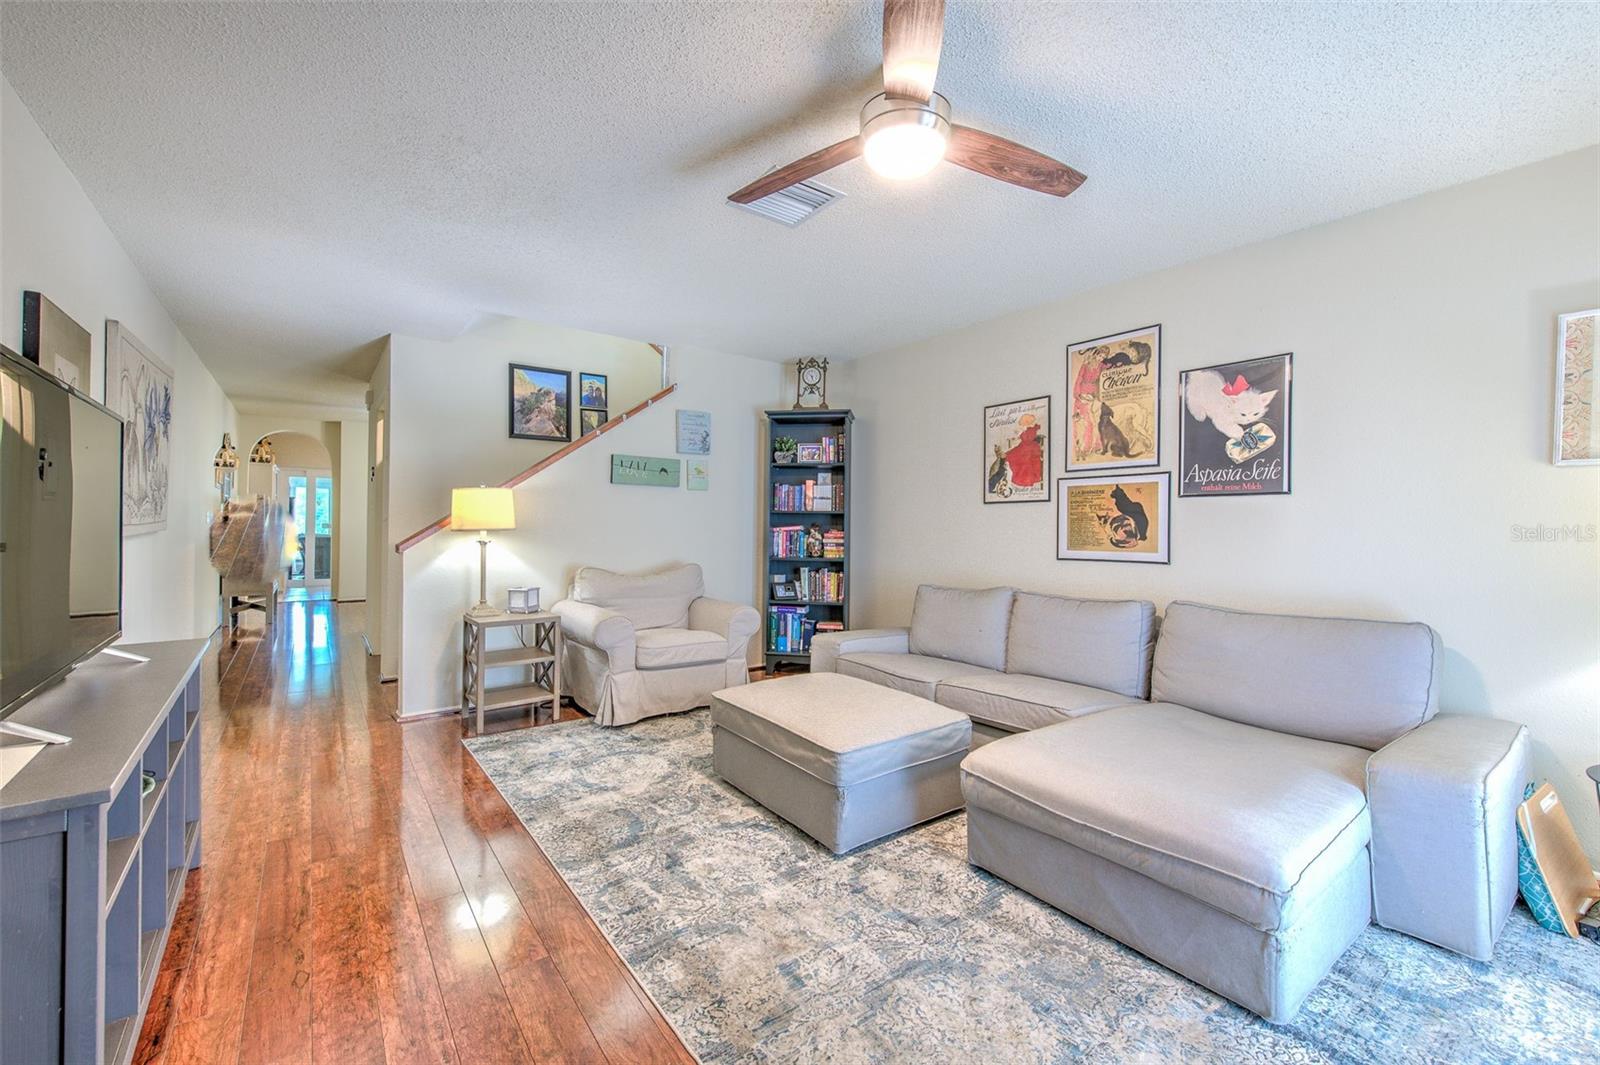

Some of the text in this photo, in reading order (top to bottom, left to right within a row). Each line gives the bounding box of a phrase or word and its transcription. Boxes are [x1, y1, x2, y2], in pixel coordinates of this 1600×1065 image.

[1184, 458, 1282, 485] Aspasia Seife
[1242, 482, 1262, 491] Milch
